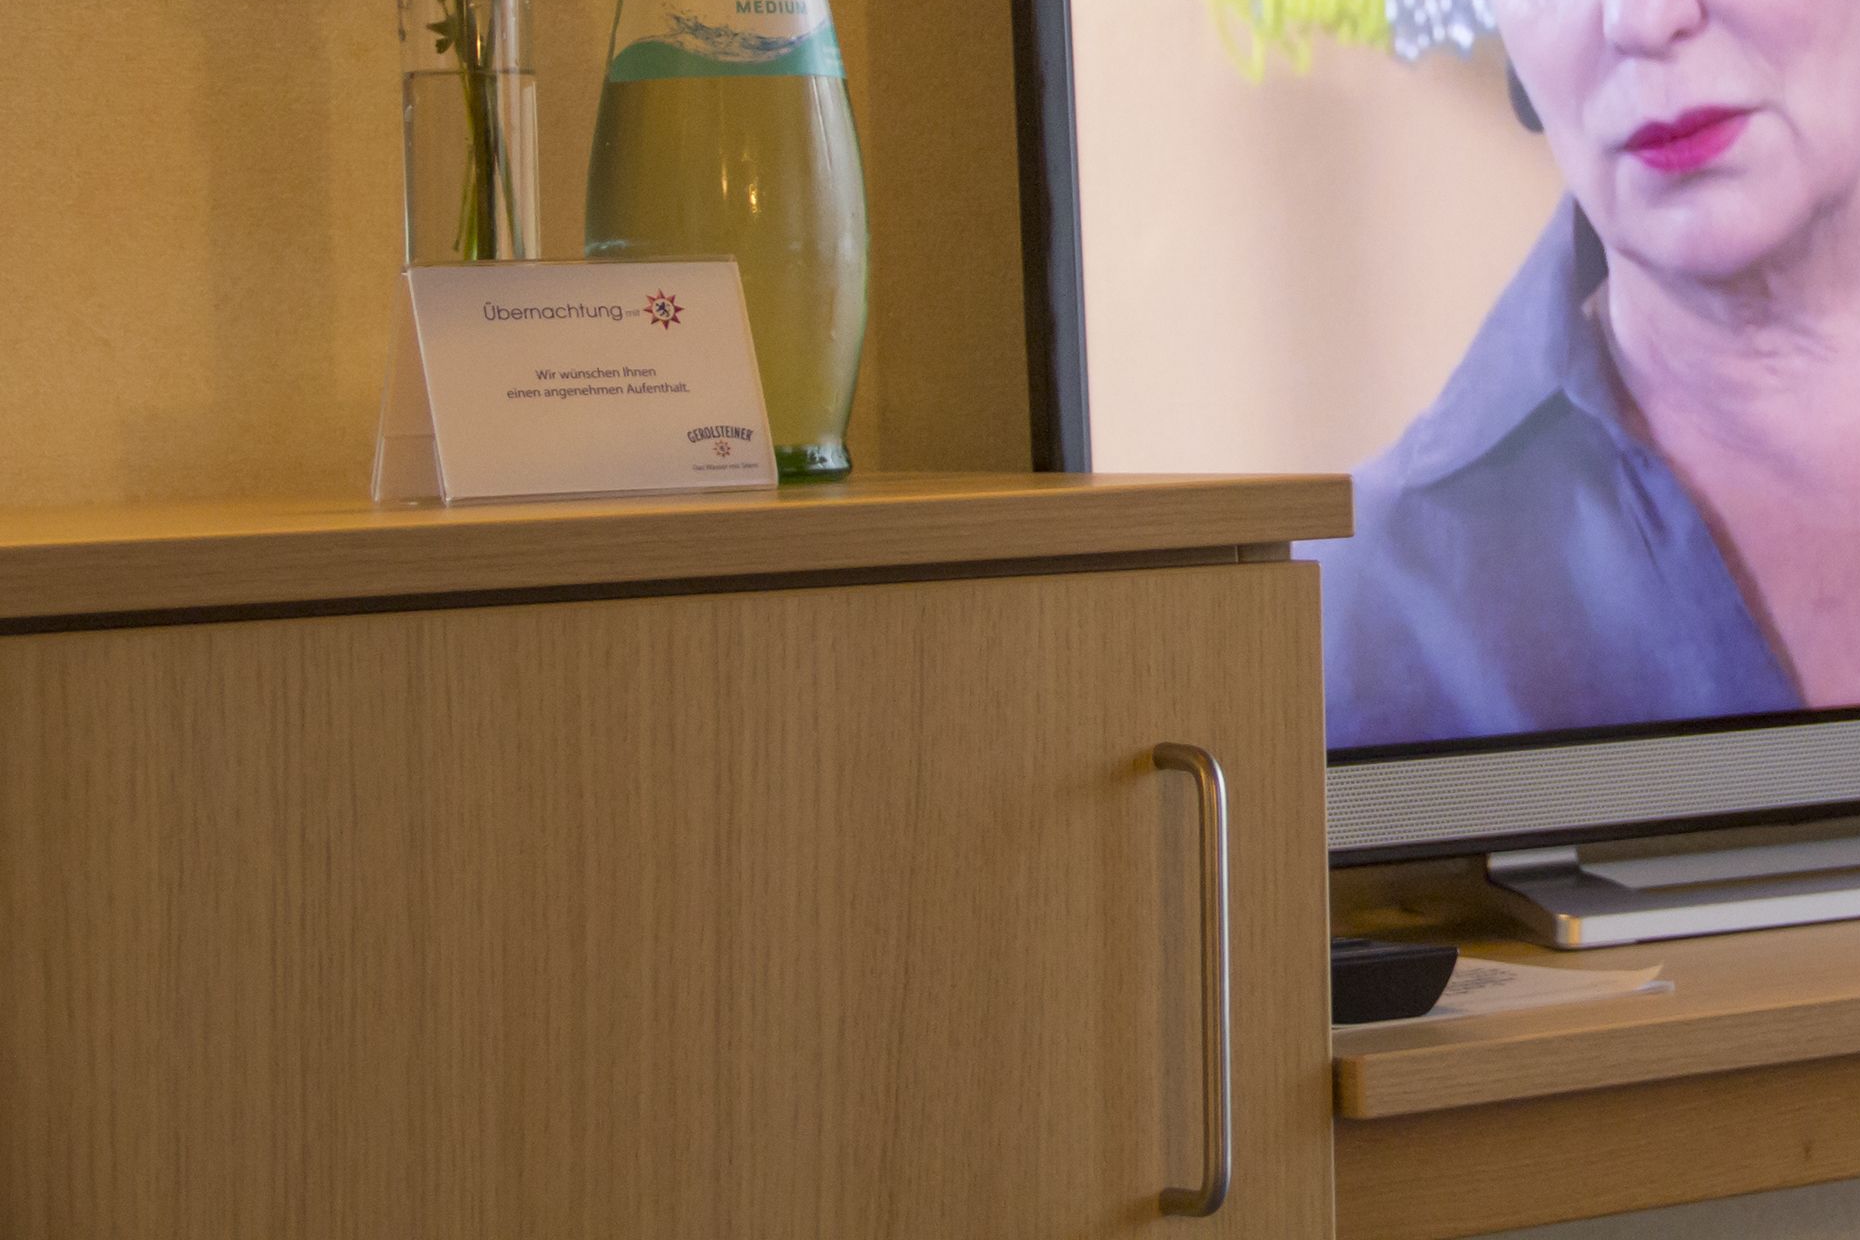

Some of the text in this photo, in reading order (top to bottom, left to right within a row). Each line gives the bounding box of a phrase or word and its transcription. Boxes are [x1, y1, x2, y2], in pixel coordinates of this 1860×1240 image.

[735, 0, 808, 15] MEDIUM
[483, 301, 623, 322] Übernachtung
[535, 362, 656, 380] Wir wünschen Ihnen
[507, 381, 690, 400] einen angenehmen Aufenthalt.
[687, 425, 754, 443] GEROLSTEINER
